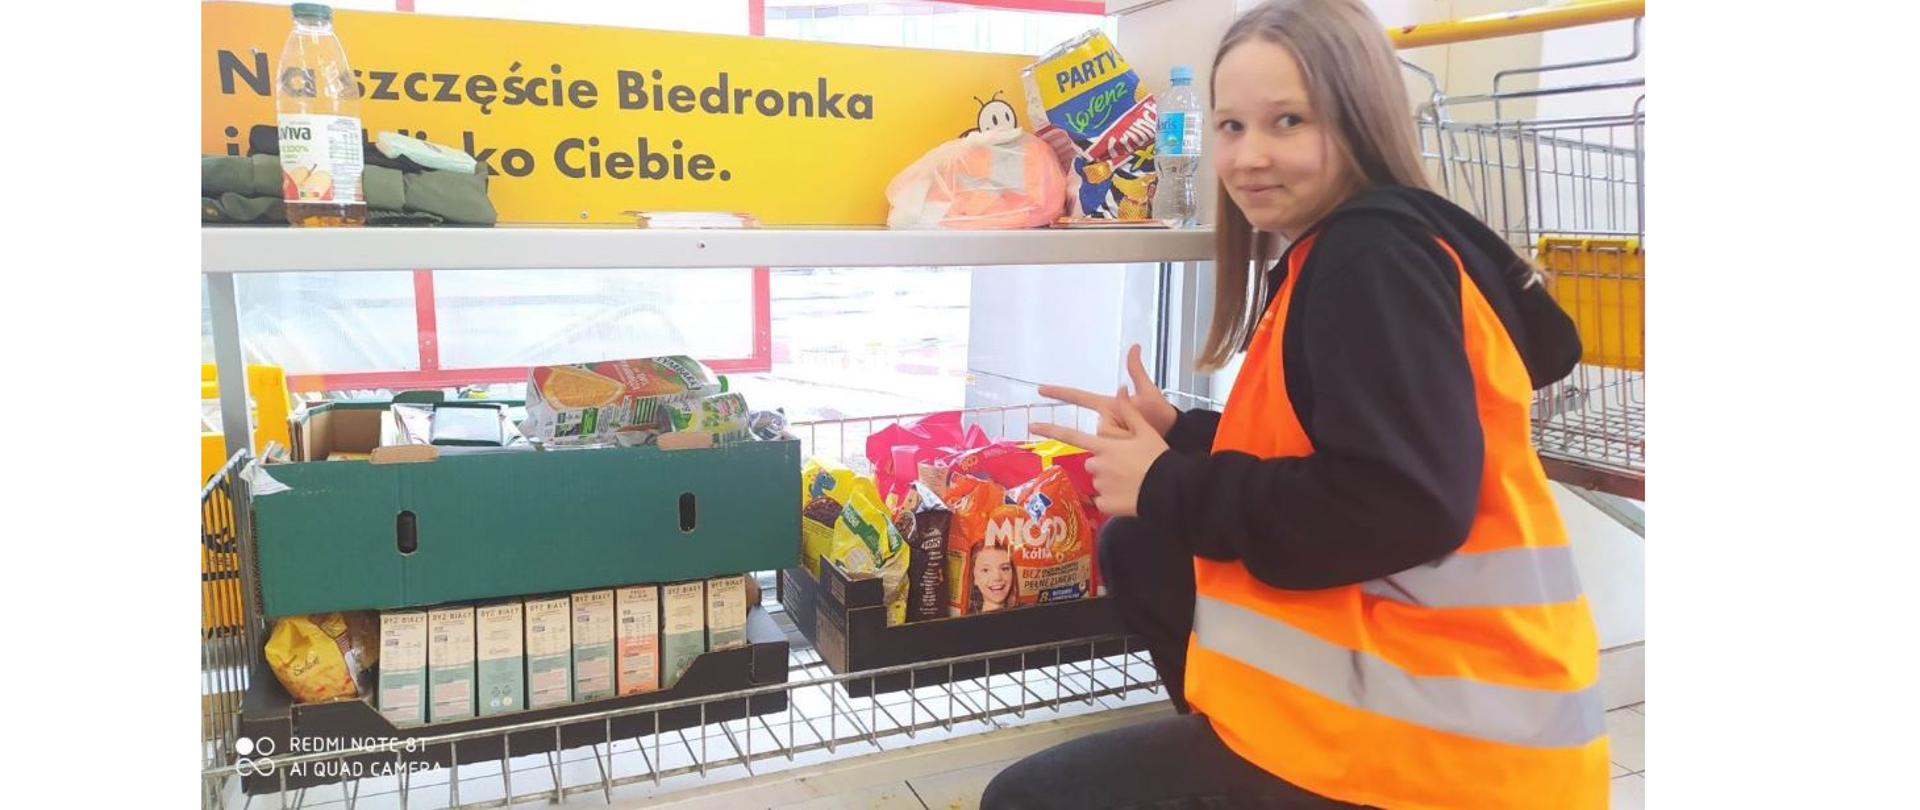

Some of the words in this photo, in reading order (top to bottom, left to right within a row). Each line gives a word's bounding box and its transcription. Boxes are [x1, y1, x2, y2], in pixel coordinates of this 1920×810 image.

[217, 49, 316, 98] Na
[617, 69, 874, 120] Biedronka
[1055, 49, 1118, 94] PARTY
[554, 136, 731, 181] Ciebie.
